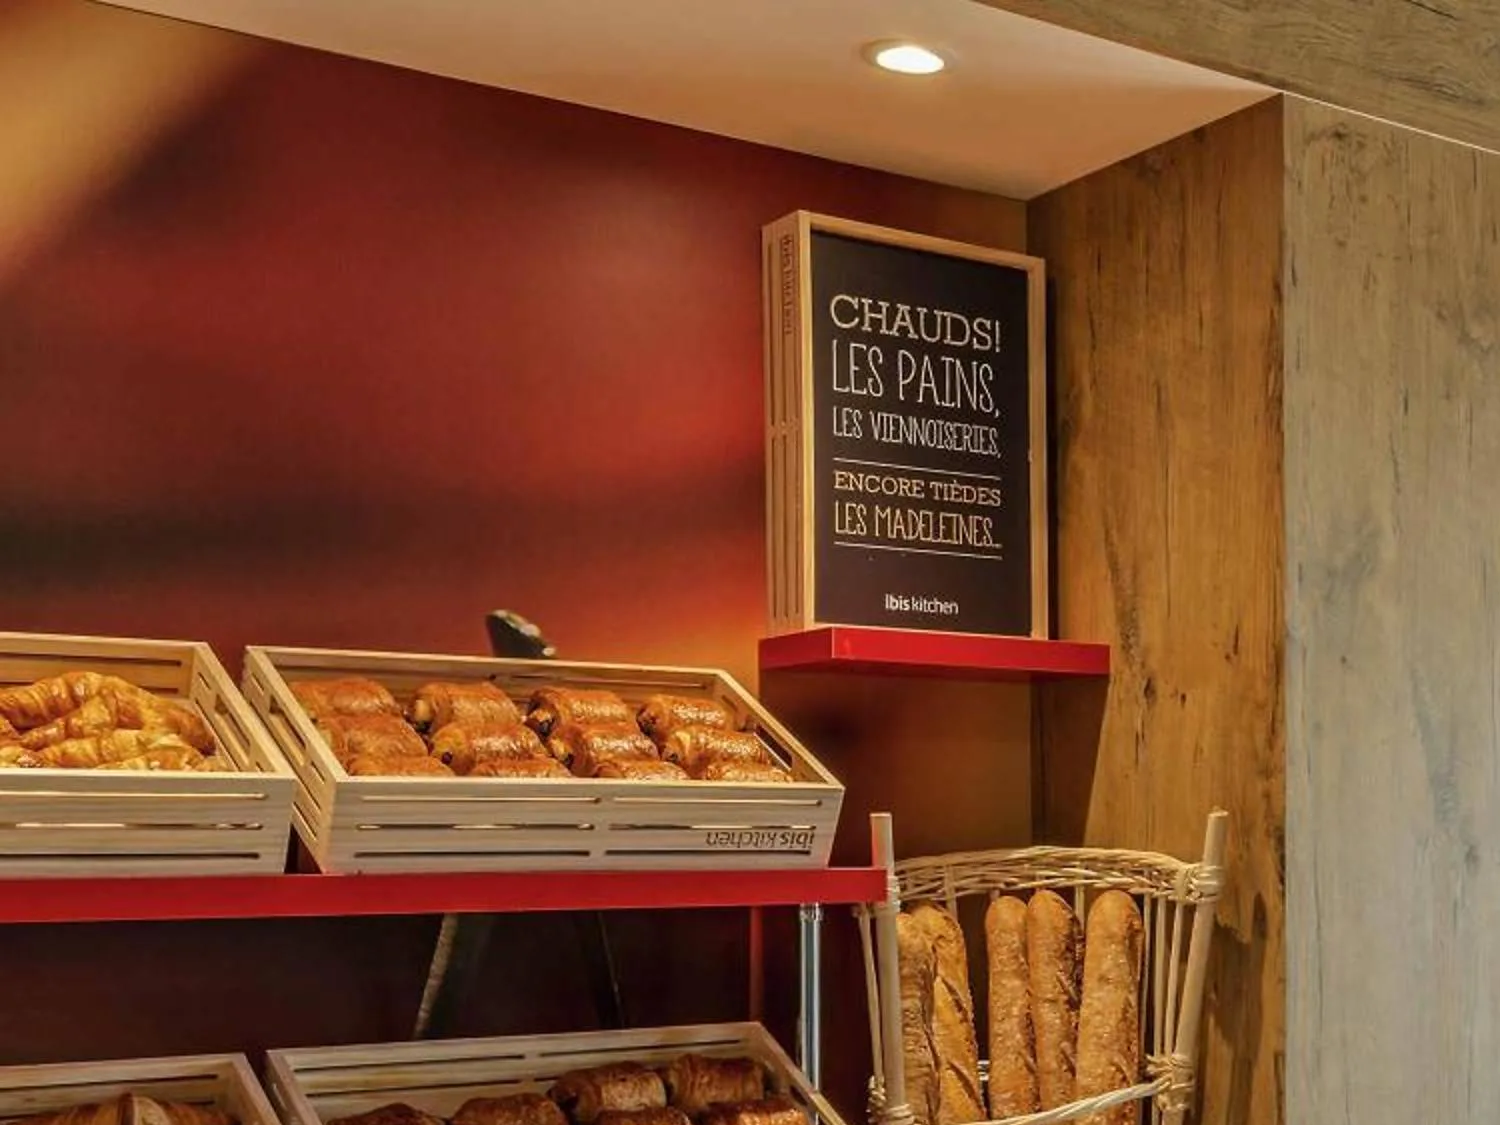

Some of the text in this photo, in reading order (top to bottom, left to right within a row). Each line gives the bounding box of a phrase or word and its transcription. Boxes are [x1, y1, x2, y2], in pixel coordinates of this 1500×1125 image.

[829, 294, 1001, 353] CHAUDS!
[832, 339, 1000, 418] LES PAINS,
[832, 405, 862, 439] LES
[832, 471, 1001, 507] ENCORE TIÈDES
[834, 502, 867, 537] LES
[705, 831, 816, 850] ibis kitchen
